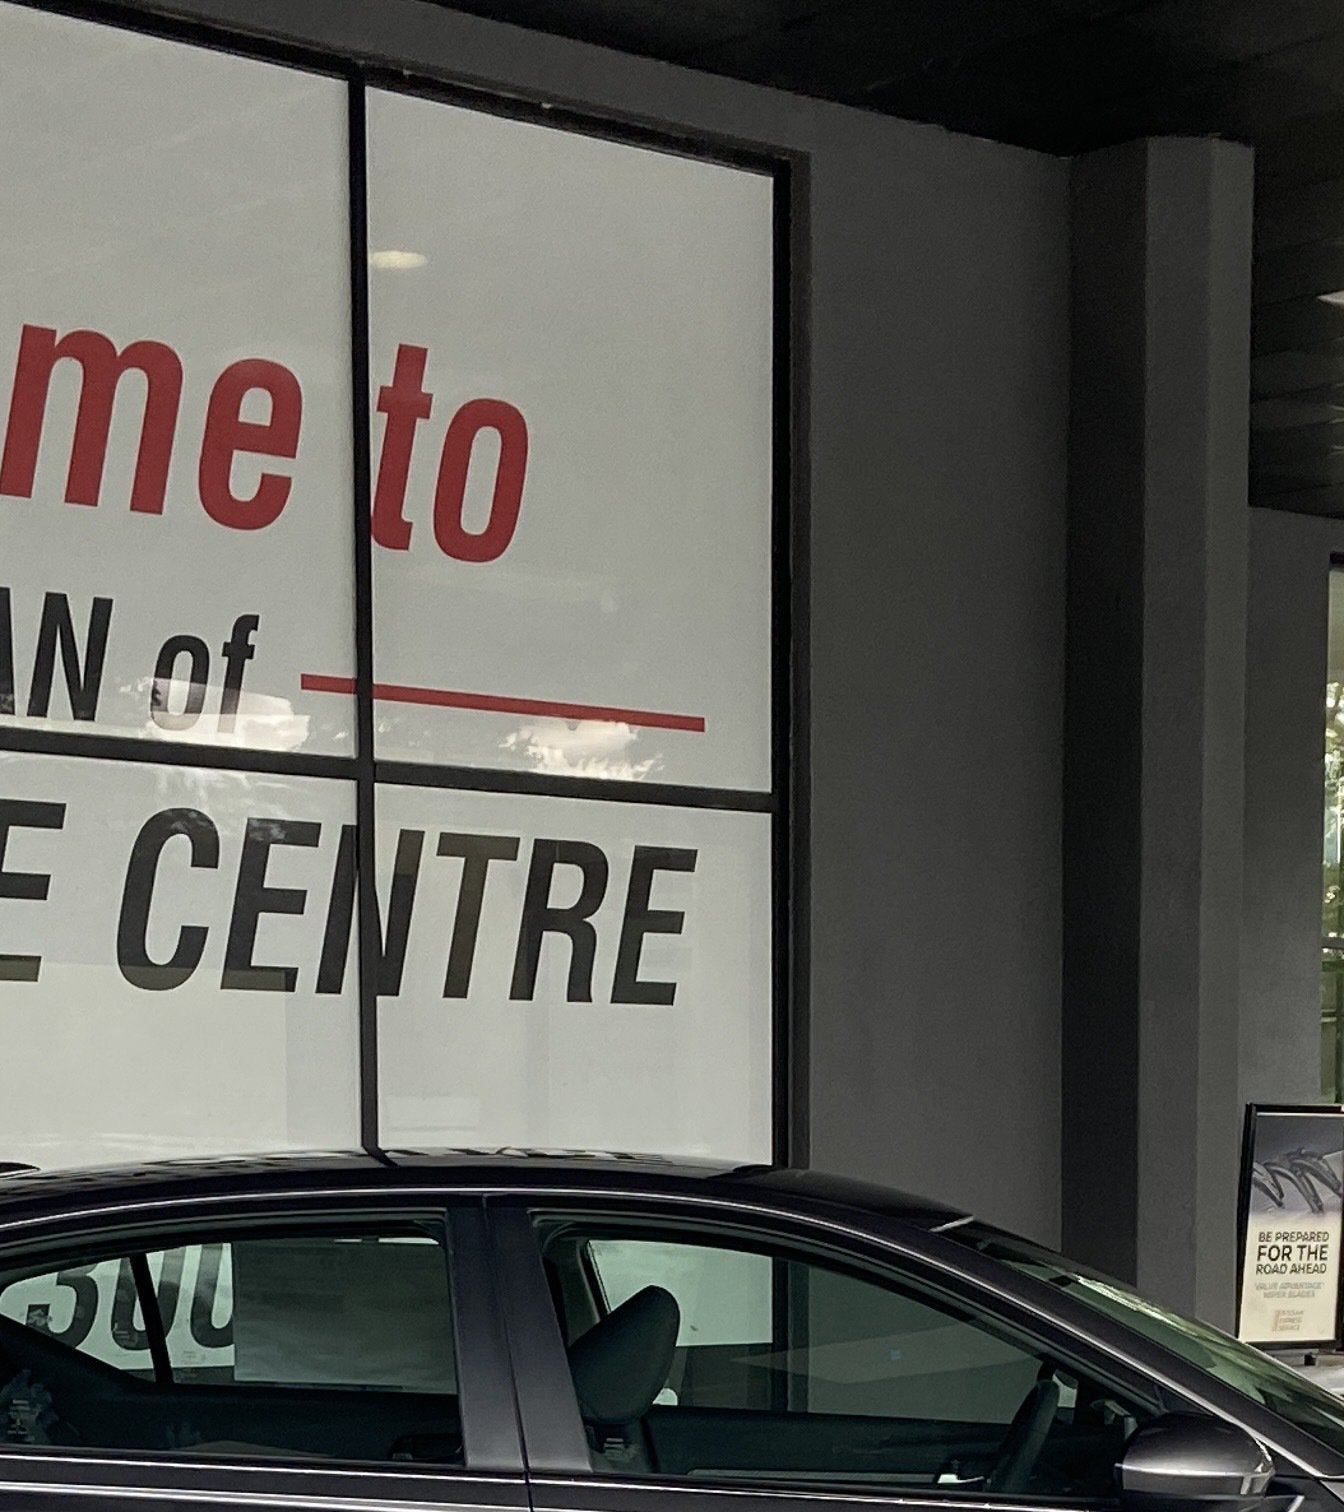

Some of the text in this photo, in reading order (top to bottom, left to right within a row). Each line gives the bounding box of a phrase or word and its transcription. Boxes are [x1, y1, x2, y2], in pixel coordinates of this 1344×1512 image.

[369, 344, 529, 563] to
[148, 613, 260, 733] of
[115, 807, 698, 1006] CENTRE
[1256, 1263, 1327, 1275] ROAD AHEAD
[1257, 1244, 1329, 1261] FOR THE
[1258, 1231, 1330, 1243] BE PREPARED
